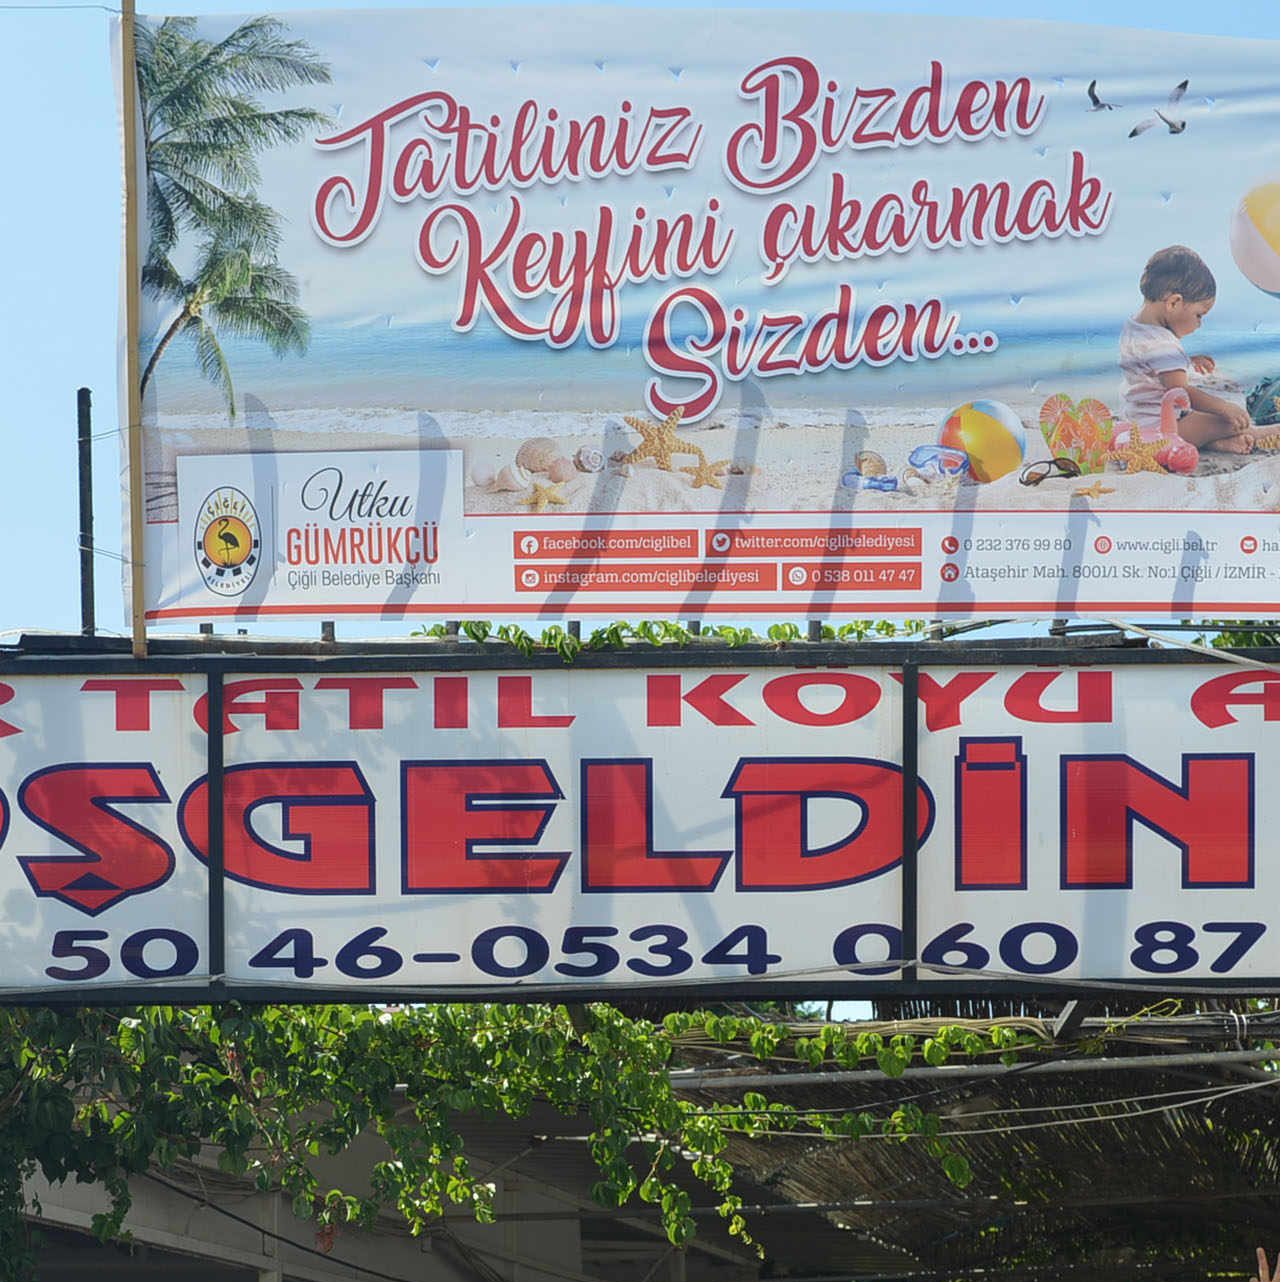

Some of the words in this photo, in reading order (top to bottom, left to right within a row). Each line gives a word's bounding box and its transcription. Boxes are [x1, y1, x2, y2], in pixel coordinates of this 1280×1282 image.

[314, 89, 704, 243] Tatiliniz
[726, 56, 1047, 190] Bizden
[417, 195, 735, 345] Keyfini
[761, 150, 1112, 282] çıkarmak
[301, 466, 413, 523] Utku
[286, 521, 439, 569] GÜMRÜKÇÜ
[542, 534, 692, 551] facebook.com/ciglibel
[734, 533, 916, 550] twitter.com/ciglibelediyesi
[963, 539, 972, 551] 0
[976, 539, 1002, 551] 232
[1004, 539, 1030, 551] 376
[1033, 539, 1051, 551] 99
[1054, 539, 1072, 551] 80
[1116, 538, 1218, 554] www.cigli.bel.tr
[287, 570, 318, 591] Çiğli
[321, 569, 381, 589] Belediye
[385, 567, 441, 589] Başkanı
[543, 569, 760, 585] instagram.com/ciglibelediyesi
[811, 570, 821, 582] 0
[823, 569, 851, 582] 538
[853, 569, 876, 582] 011
[878, 569, 895, 582] 47
[898, 569, 916, 582] 47
[963, 566, 1029, 582] Ataşehir
[1033, 566, 1069, 579] Mah.
[1072, 566, 1120, 580] 8001/1
[1122, 566, 1144, 579] Sk.
[1147, 566, 1178, 580] No:1
[1181, 565, 1213, 582] Çiğli
[1214, 566, 1221, 579] /
[1223, 563, 1267, 580] İZMİR
[45, 928, 201, 979] 50
[832, 921, 1080, 978] 060
[1130, 920, 1268, 975] 87
